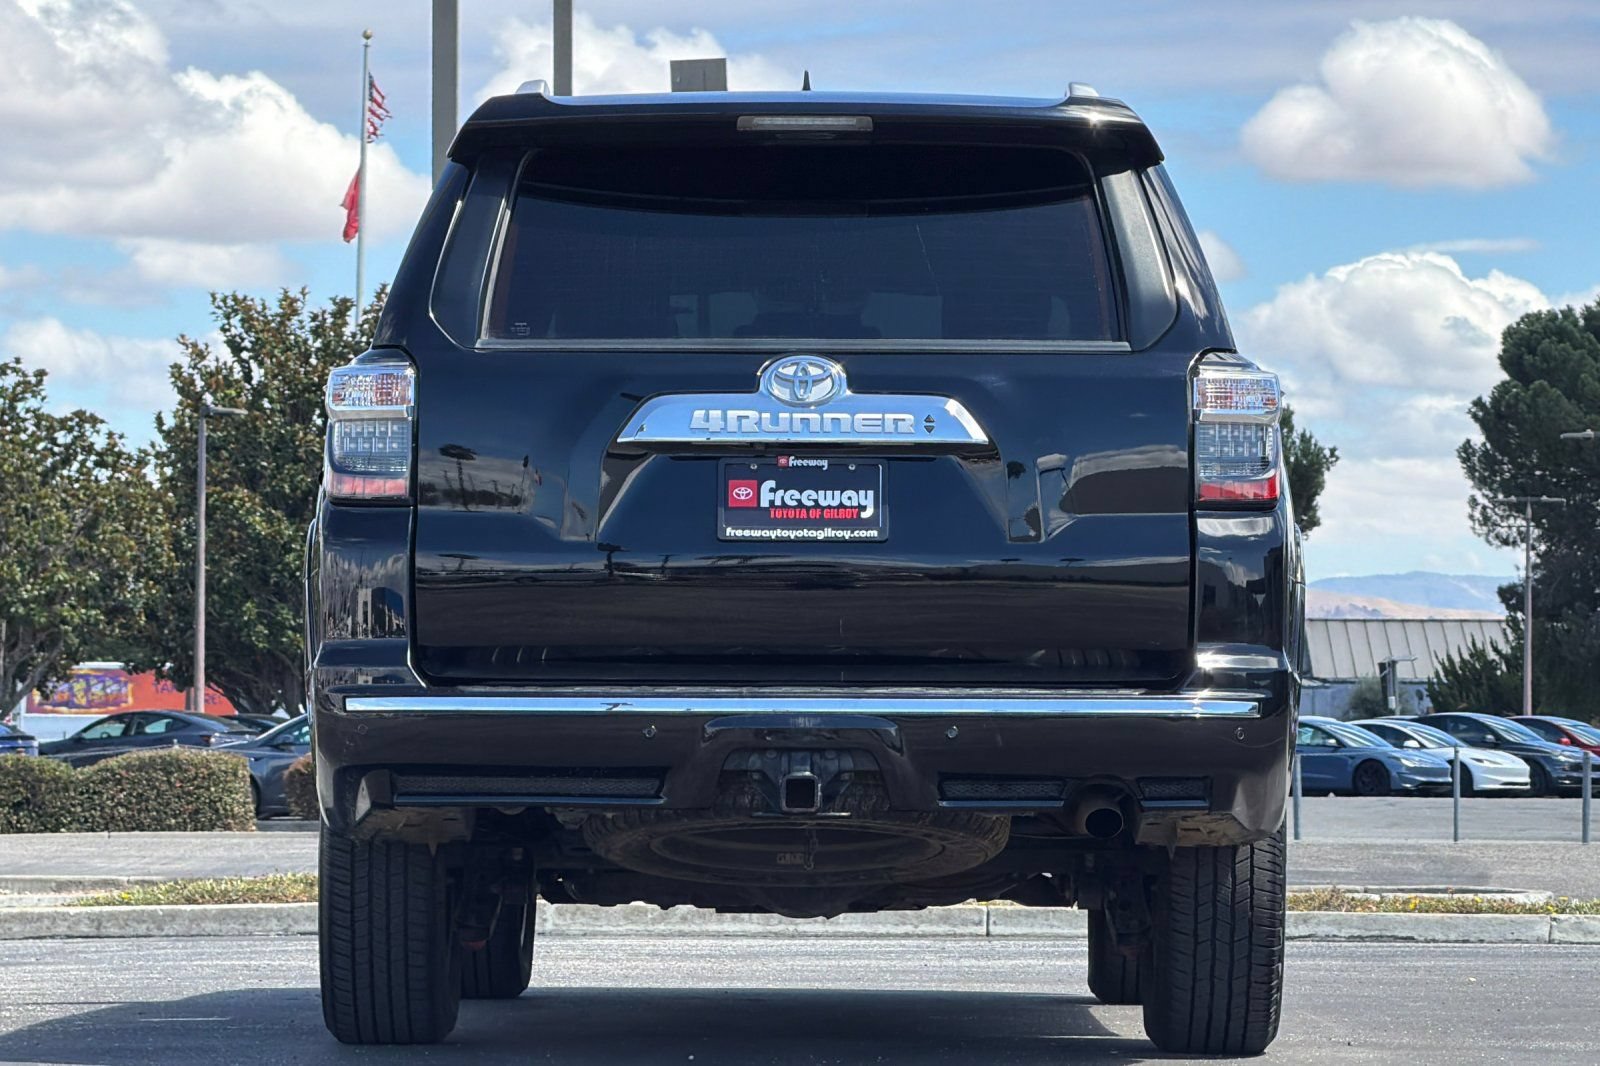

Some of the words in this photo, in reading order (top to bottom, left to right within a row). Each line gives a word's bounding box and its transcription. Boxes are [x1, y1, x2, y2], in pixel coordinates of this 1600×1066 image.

[789, 456, 828, 470] freeway
[760, 480, 874, 518] freeway
[770, 508, 807, 518] TOYOTA
[810, 508, 821, 518] OF
[824, 508, 859, 518] GILROY
[726, 527, 878, 539] freewaytoyotagilroy.com
